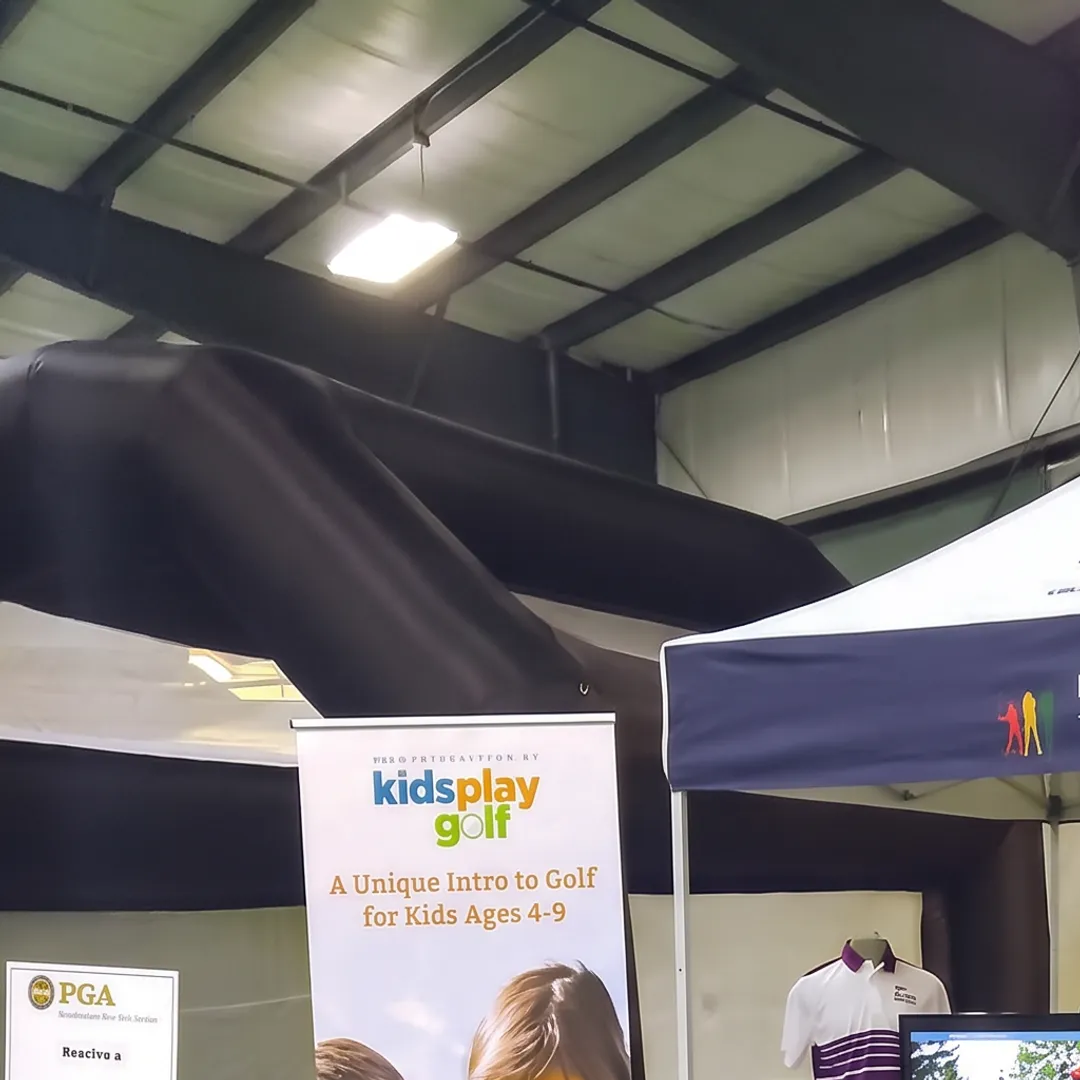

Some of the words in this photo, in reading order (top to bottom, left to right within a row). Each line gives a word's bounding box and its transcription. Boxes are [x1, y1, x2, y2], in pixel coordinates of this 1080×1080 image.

[372, 767, 541, 812] kidsplay
[434, 803, 511, 848] golf
[329, 874, 348, 895] A
[352, 872, 440, 899] Unique
[447, 871, 509, 893] Intro
[514, 871, 539, 891] to
[545, 866, 598, 889] Golf
[362, 904, 399, 928] for
[404, 903, 458, 927] Kids
[463, 904, 521, 931] Ages
[527, 902, 567, 923] 4-9
[58, 981, 116, 1007] PGA
[114, 1051, 122, 1062] a
